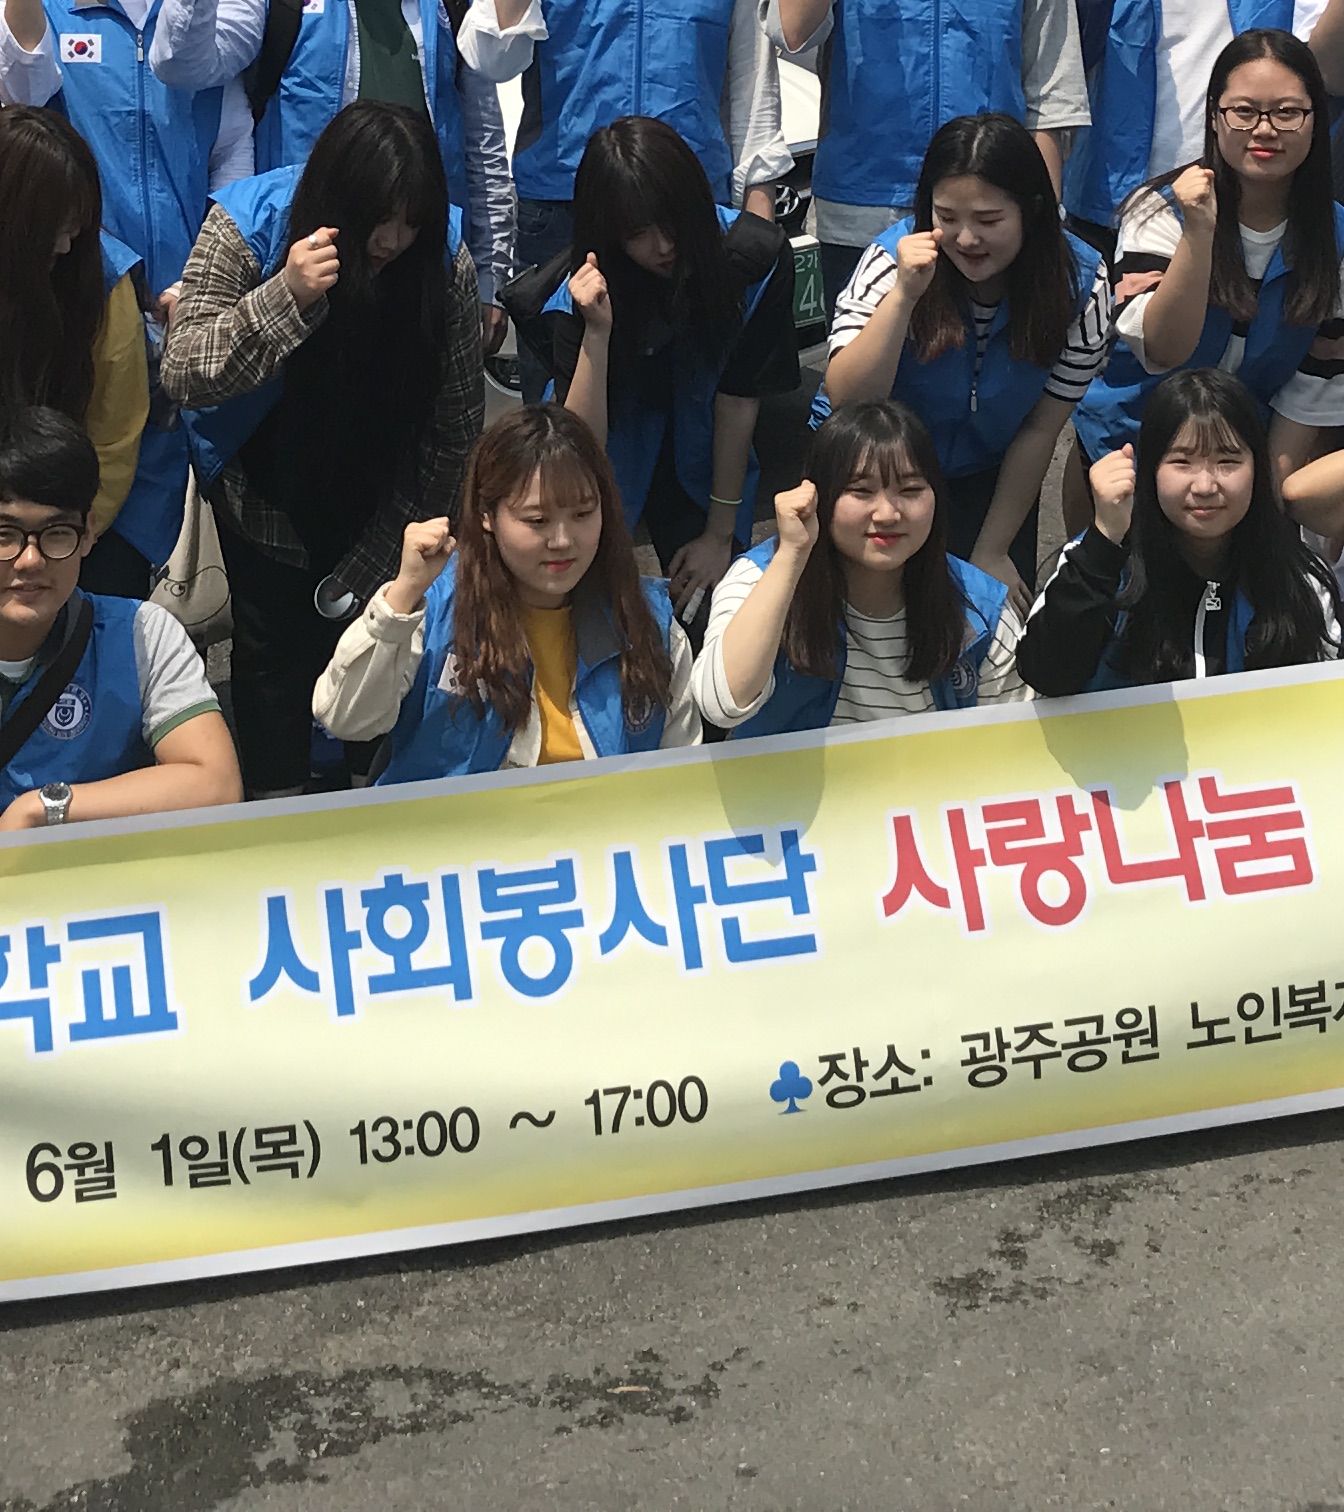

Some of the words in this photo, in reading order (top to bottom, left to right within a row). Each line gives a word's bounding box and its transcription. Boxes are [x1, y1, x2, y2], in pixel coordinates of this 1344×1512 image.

[249, 829, 817, 1017] 사회봉사단
[881, 776, 1316, 932] 사랑나눔
[817, 1045, 933, 1111] 장소:
[959, 1003, 1161, 1089] 광주공원
[25, 1140, 117, 1205] 6월
[151, 1119, 321, 1190] 1일(목)
[349, 1105, 480, 1167] 13:00
[584, 1074, 709, 1136] 17:00
